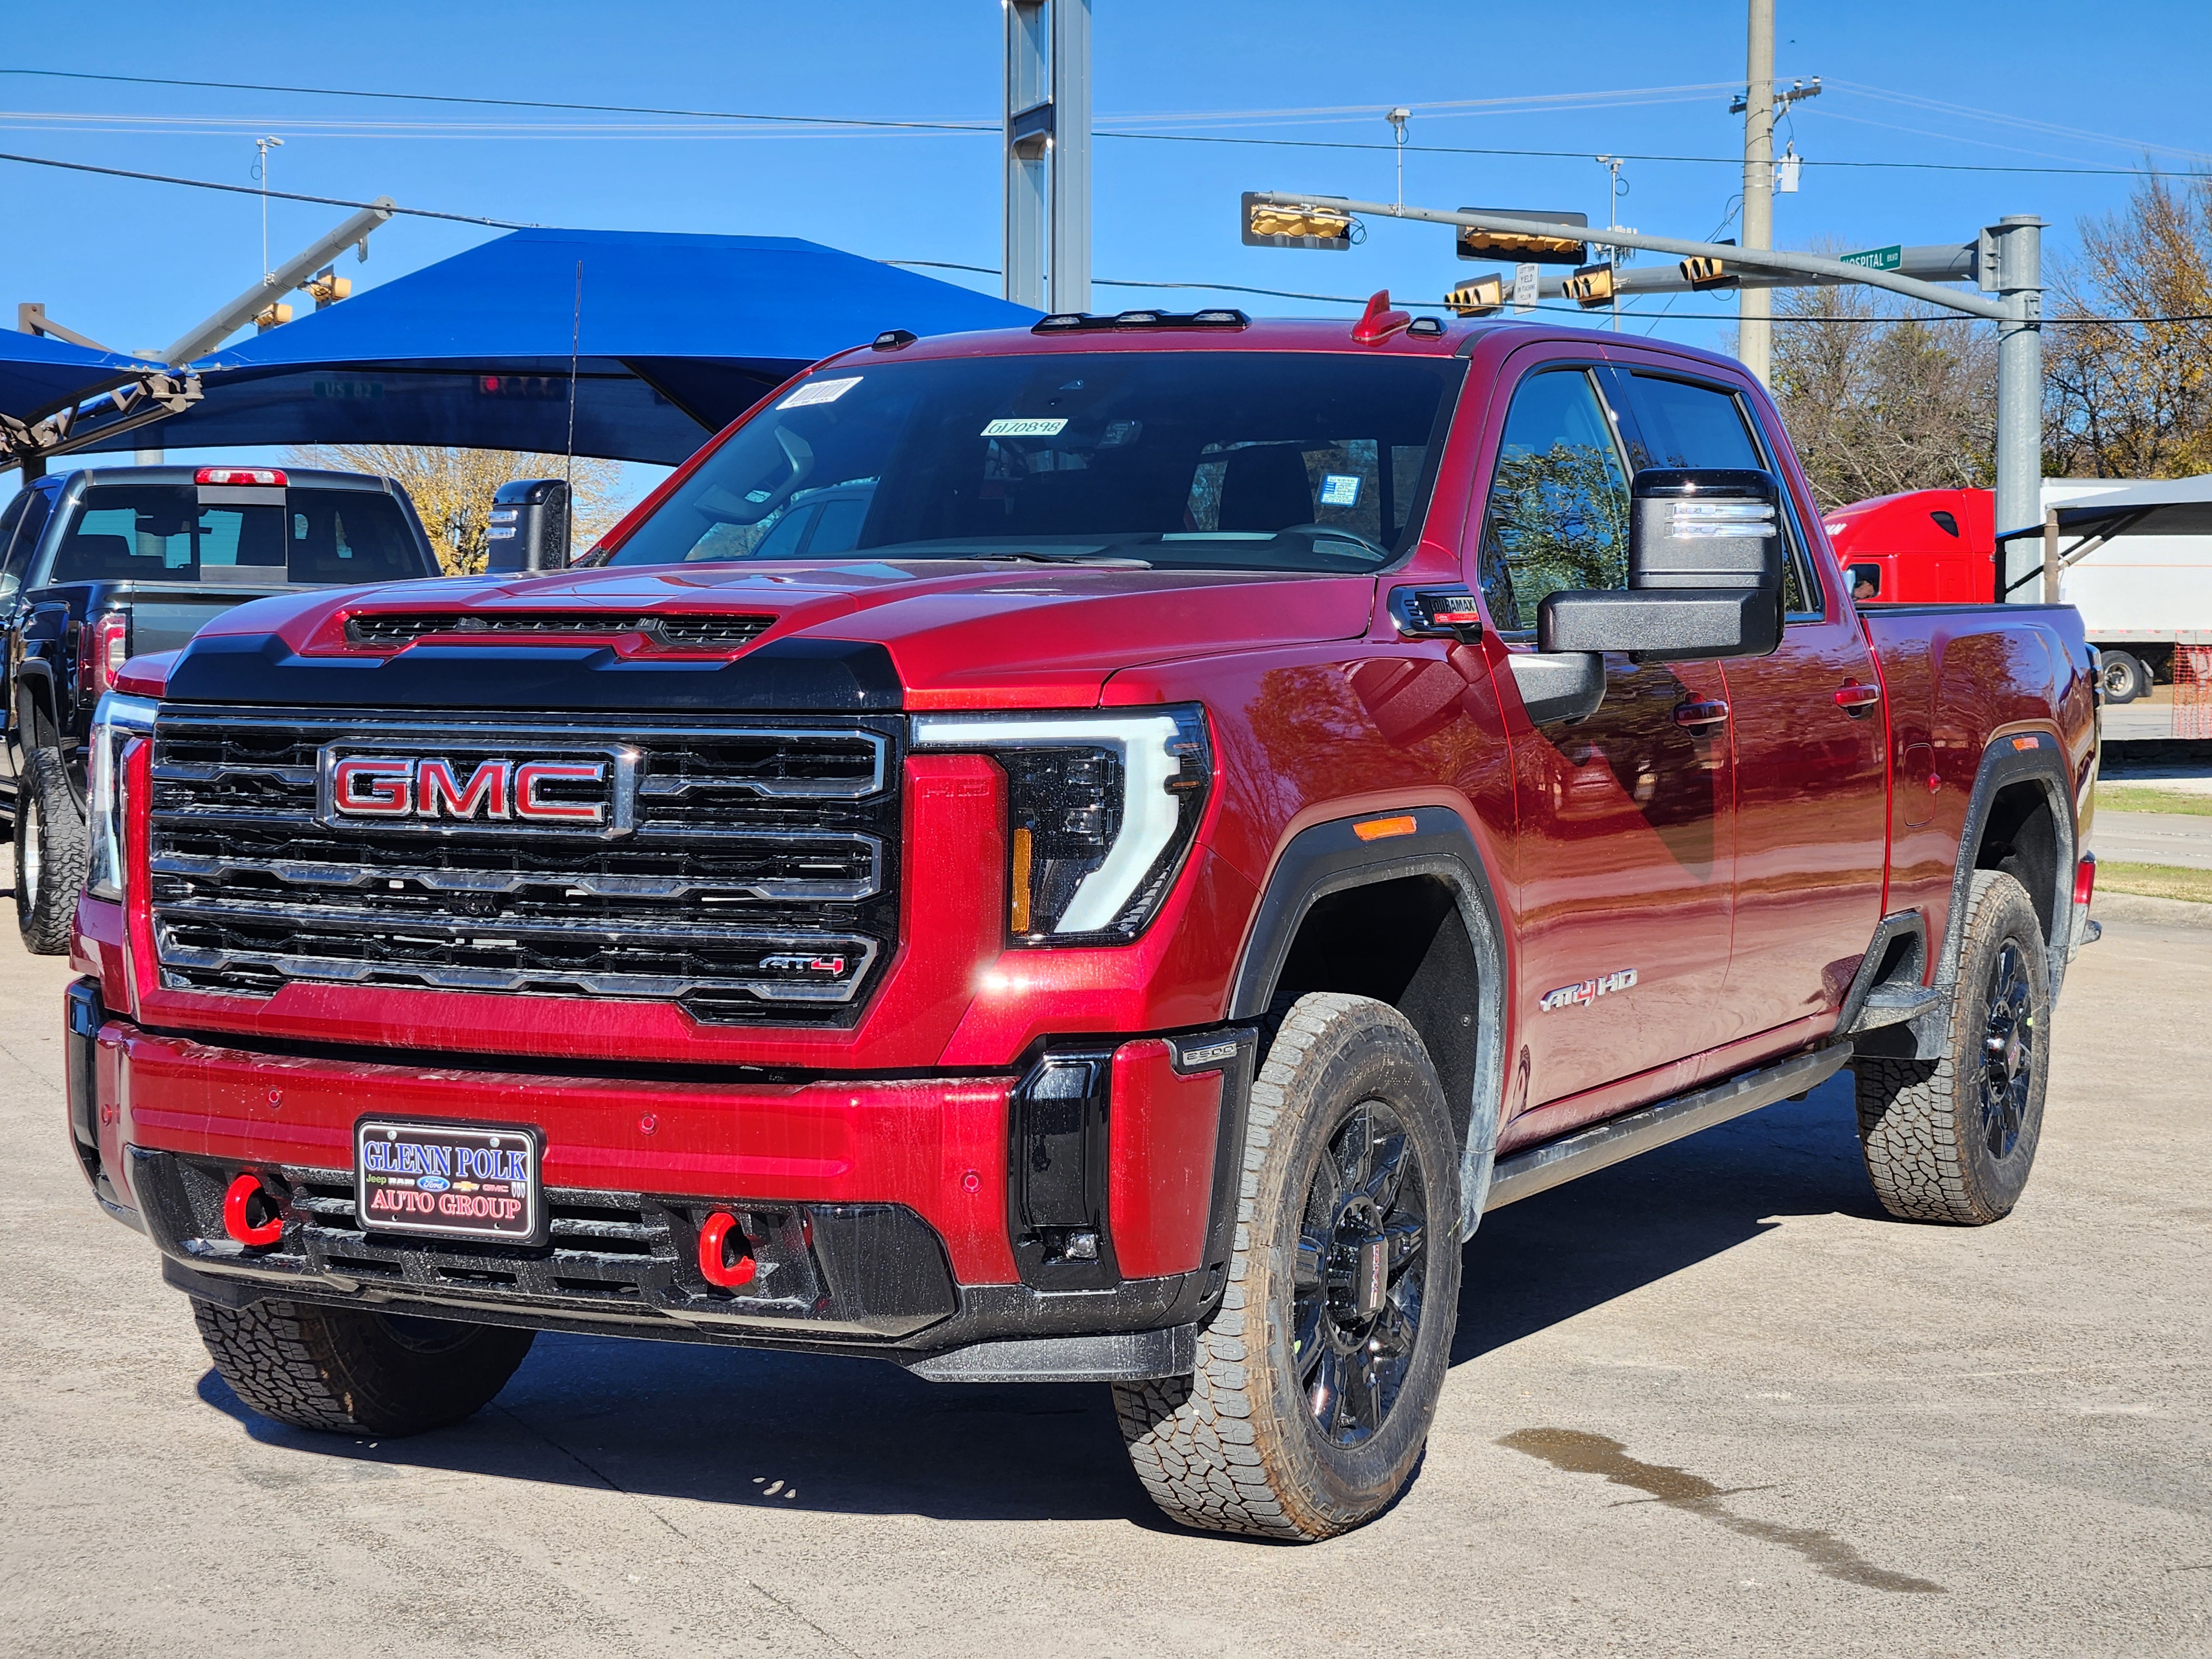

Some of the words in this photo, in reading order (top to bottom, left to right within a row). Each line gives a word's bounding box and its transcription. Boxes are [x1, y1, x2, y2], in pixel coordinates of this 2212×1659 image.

[1887, 253, 1898, 262] BLVD
[1521, 274, 1533, 283] YIELD
[325, 383, 345, 398] US
[1434, 599, 1475, 612] DURAMAX
[333, 756, 607, 822] GMC
[759, 955, 844, 977] AT4
[1539, 980, 1596, 1013] AT4
[1597, 968, 1637, 996] HD
[1187, 1046, 1234, 1061] 2500
[364, 1140, 451, 1176] GLENN
[455, 1147, 528, 1181] POLK
[366, 1173, 387, 1185] Jeep
[388, 1178, 415, 1186] RAM
[423, 1178, 444, 1190] Ford
[482, 1184, 509, 1193] GMC
[371, 1188, 435, 1214] AUTO
[439, 1194, 521, 1219] GROUP
